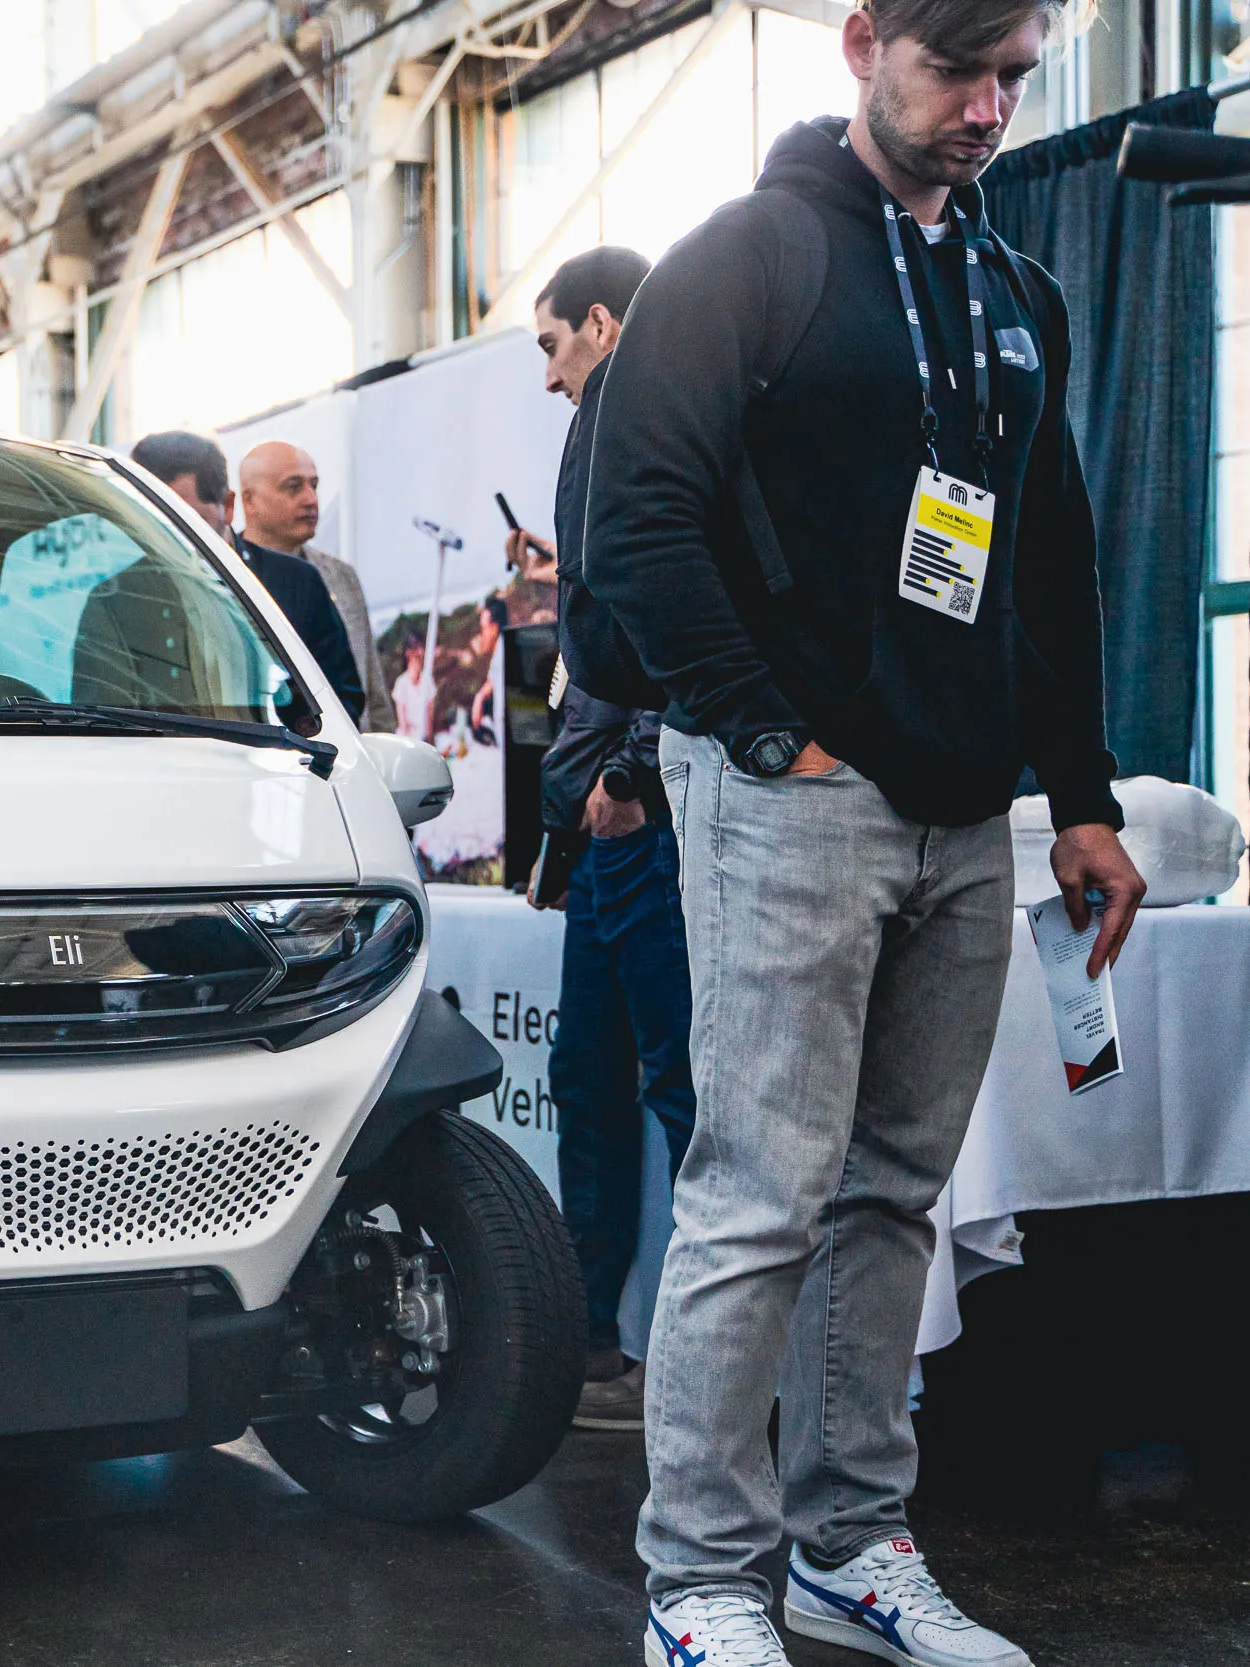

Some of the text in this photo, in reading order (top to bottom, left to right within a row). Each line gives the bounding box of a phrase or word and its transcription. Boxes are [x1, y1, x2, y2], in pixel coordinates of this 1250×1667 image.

[936, 508, 953, 520] David
[48, 935, 84, 965] Eli
[492, 1077, 558, 1133] Veh
